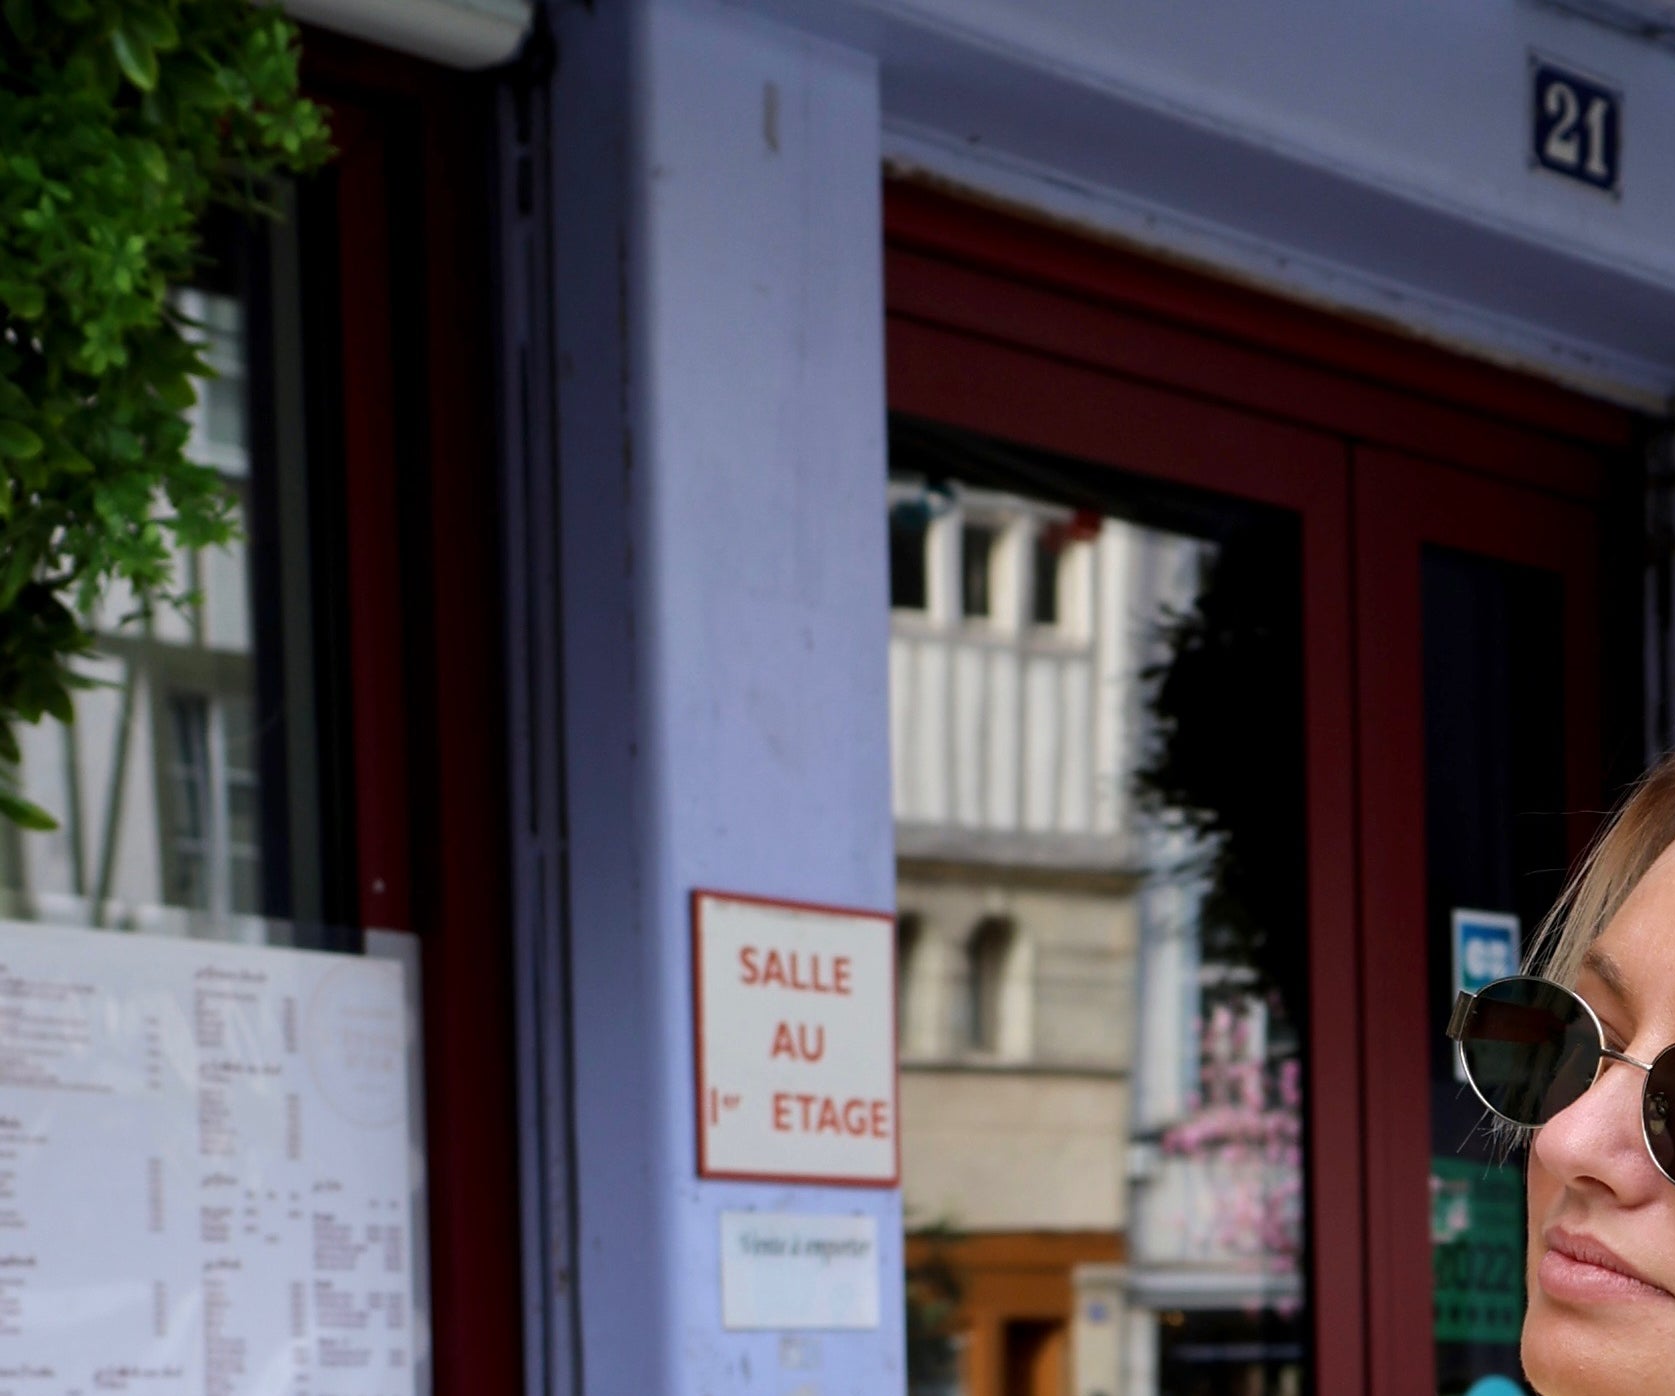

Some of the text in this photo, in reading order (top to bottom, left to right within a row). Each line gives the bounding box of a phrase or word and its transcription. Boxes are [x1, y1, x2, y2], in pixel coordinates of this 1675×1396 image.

[1544, 81, 1609, 177] 21
[738, 945, 853, 995] SALLE
[770, 1020, 826, 1063] AU
[771, 1092, 889, 1139] ETAGE
